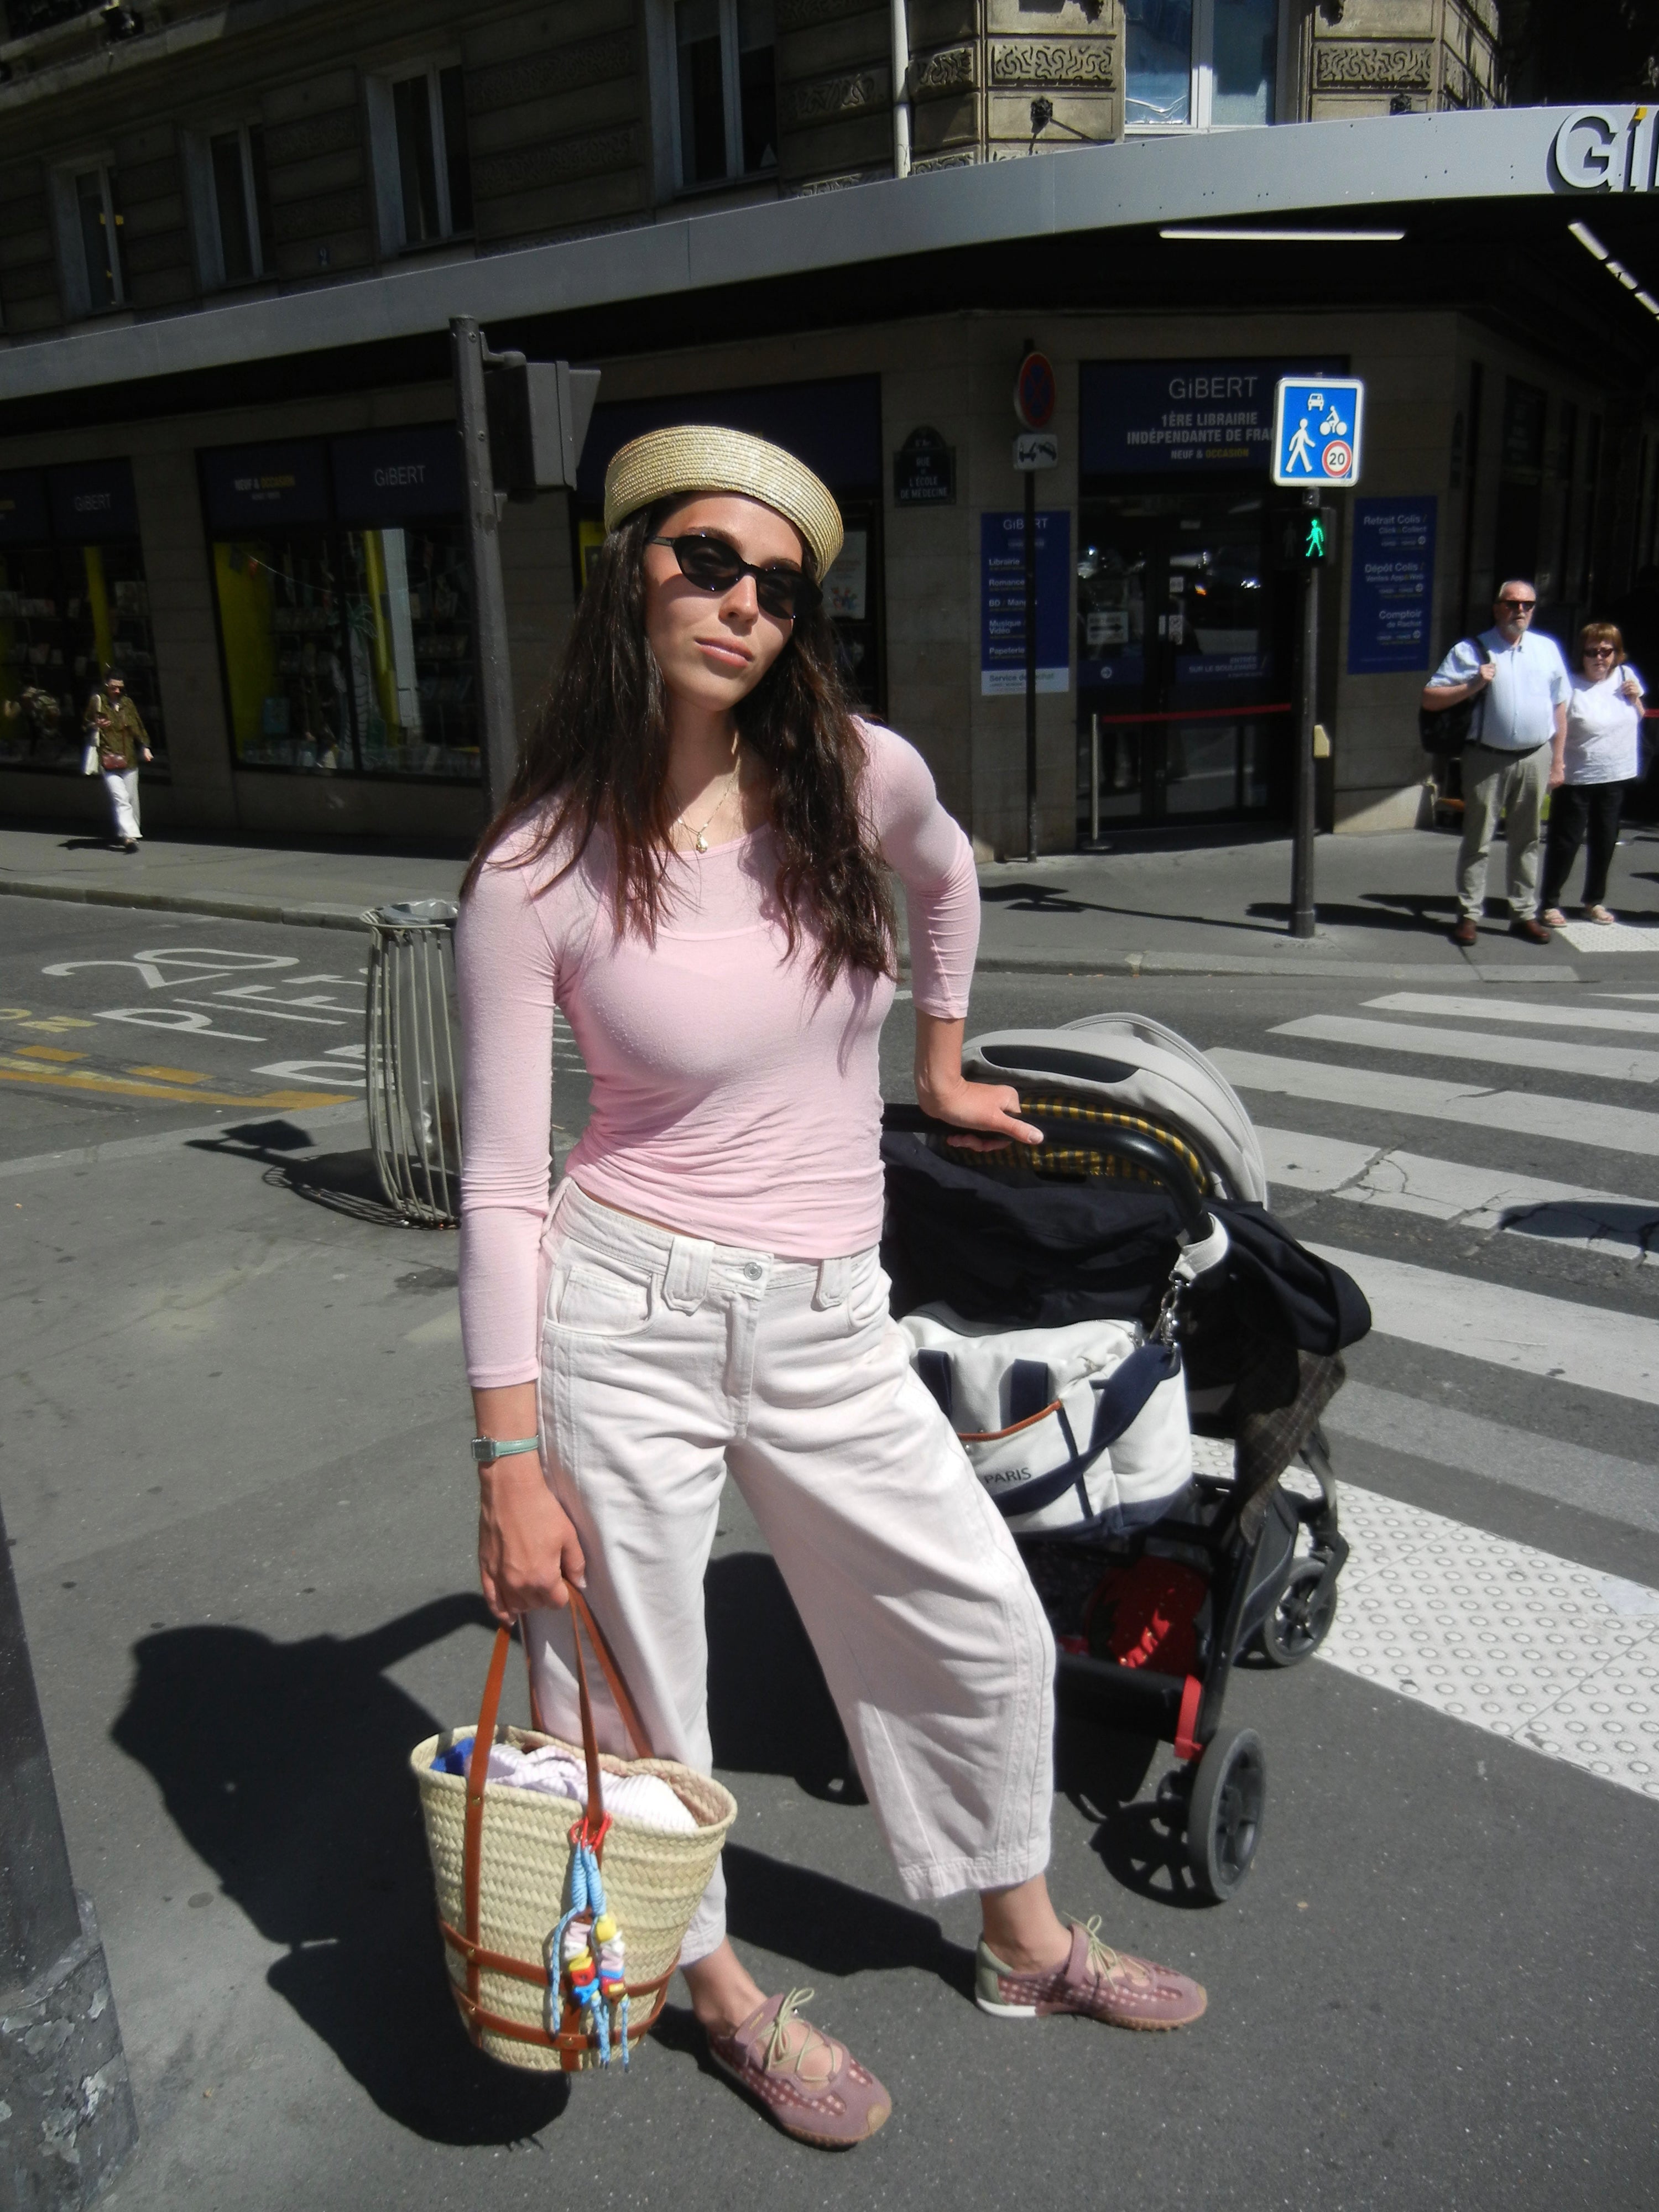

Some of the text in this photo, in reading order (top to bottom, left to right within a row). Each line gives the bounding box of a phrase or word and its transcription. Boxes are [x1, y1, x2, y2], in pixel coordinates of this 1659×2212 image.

[1554, 106, 1659, 189] Gi
[1162, 410, 1258, 427] 1ÈRE LIBRAIRIE
[1127, 427, 1273, 445] INDÉPENDANTE DE FRA
[1171, 447, 1249, 460] NEUF & OCCASION
[1329, 452, 1345, 465] 20
[916, 456, 930, 467] RUE
[1003, 518, 1048, 530] GiBRT
[1364, 515, 1395, 525] Retrait
[1397, 514, 1420, 524] Colis
[1395, 562, 1418, 572] Colis
[989, 598, 1000, 607] BD
[1379, 609, 1422, 619] Comptoir
[989, 619, 1021, 628] Musique
[989, 647, 1025, 655] Papeterie
[984, 1467, 1032, 1484] PARIS
